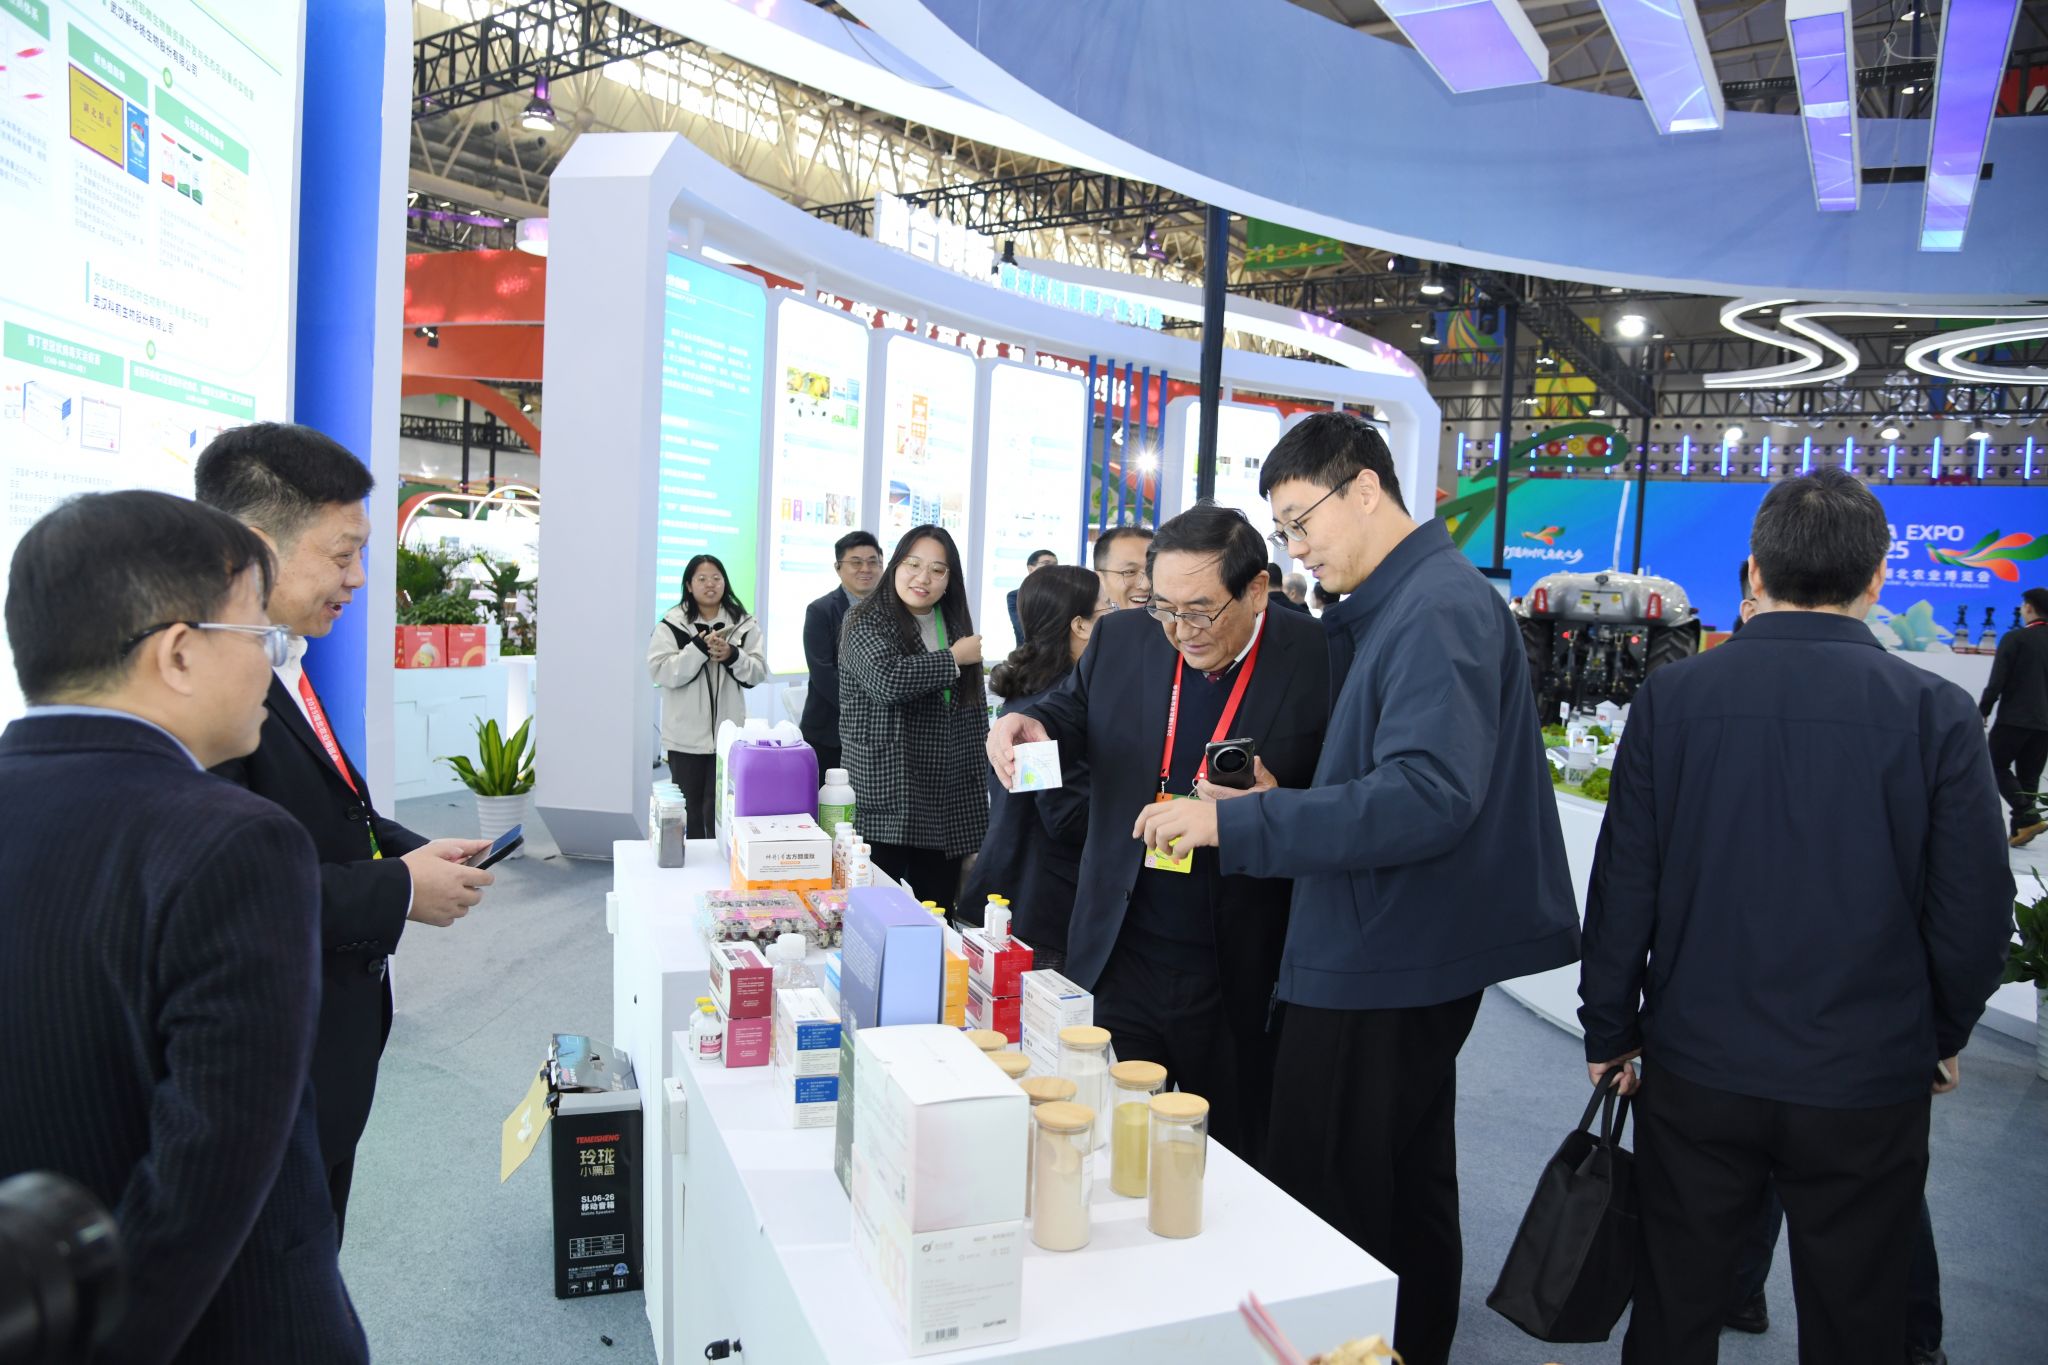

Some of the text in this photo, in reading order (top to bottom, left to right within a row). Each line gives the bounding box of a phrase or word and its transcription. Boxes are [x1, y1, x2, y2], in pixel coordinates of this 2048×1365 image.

[1905, 524, 1965, 541] EXPO
[576, 1134, 620, 1144] TEMEISHENG
[579, 1148, 615, 1165] 玲珑
[581, 1194, 615, 1203] SL06-26
[581, 1201, 615, 1211] 移动音箱
